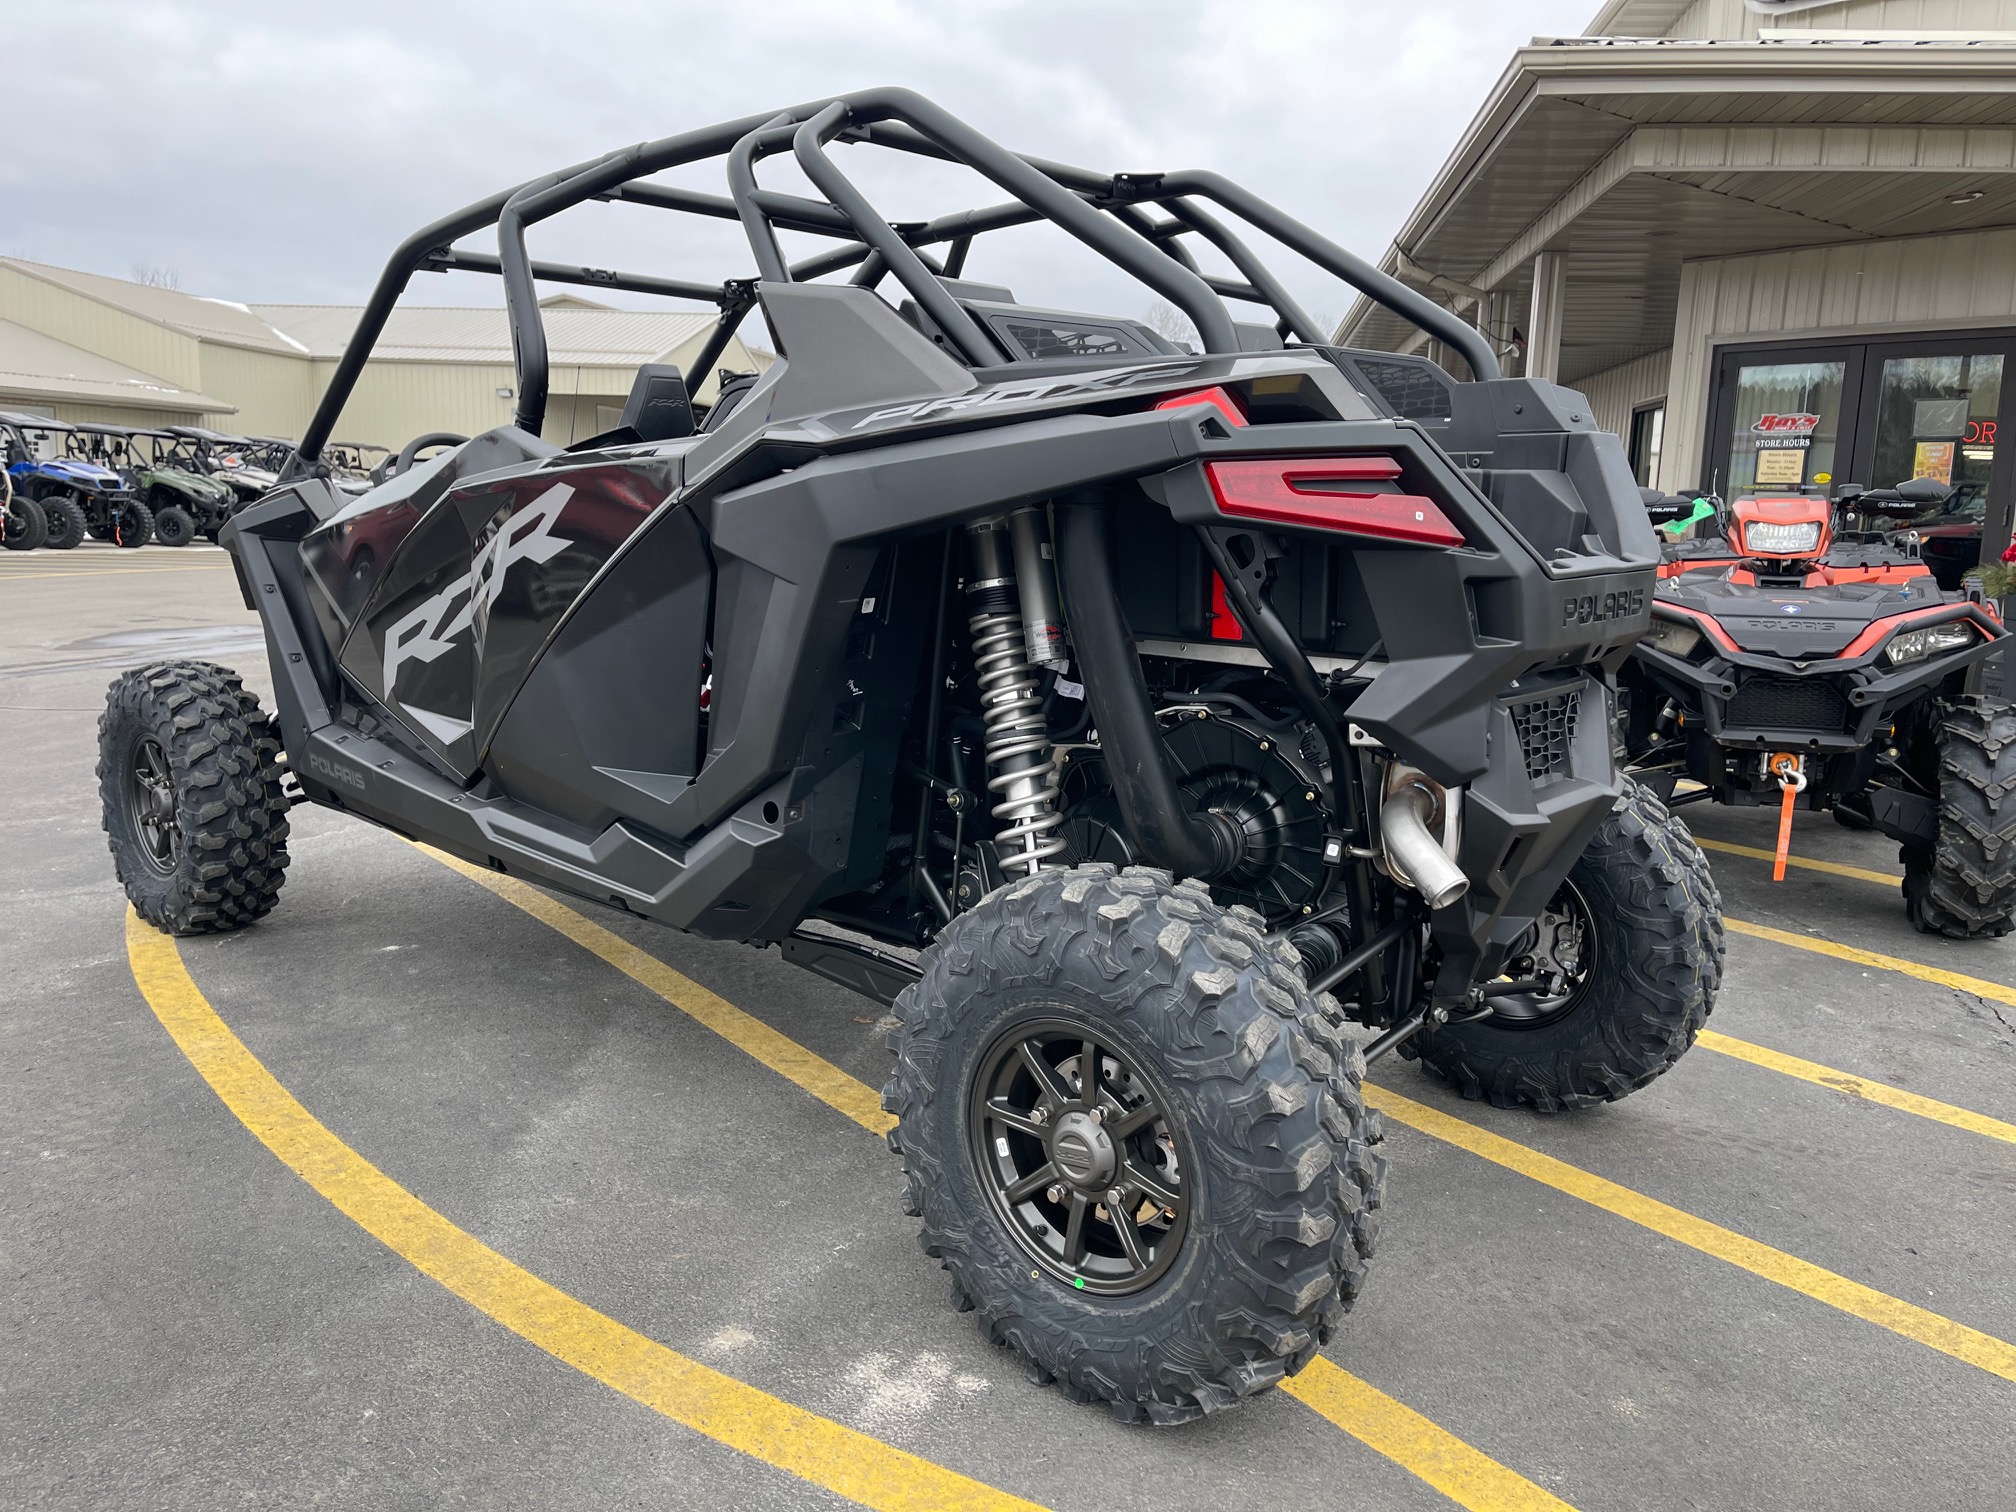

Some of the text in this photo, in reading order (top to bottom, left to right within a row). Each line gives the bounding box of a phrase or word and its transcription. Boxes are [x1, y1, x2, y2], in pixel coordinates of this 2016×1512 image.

[1760, 415, 1818, 431] Ray's
[1755, 439, 1810, 448] STORE HOURS
[383, 481, 576, 702] RZR
[1562, 588, 1644, 628] POLARIS
[1747, 620, 1836, 631] POLARIS
[308, 751, 366, 790] POLARIS
